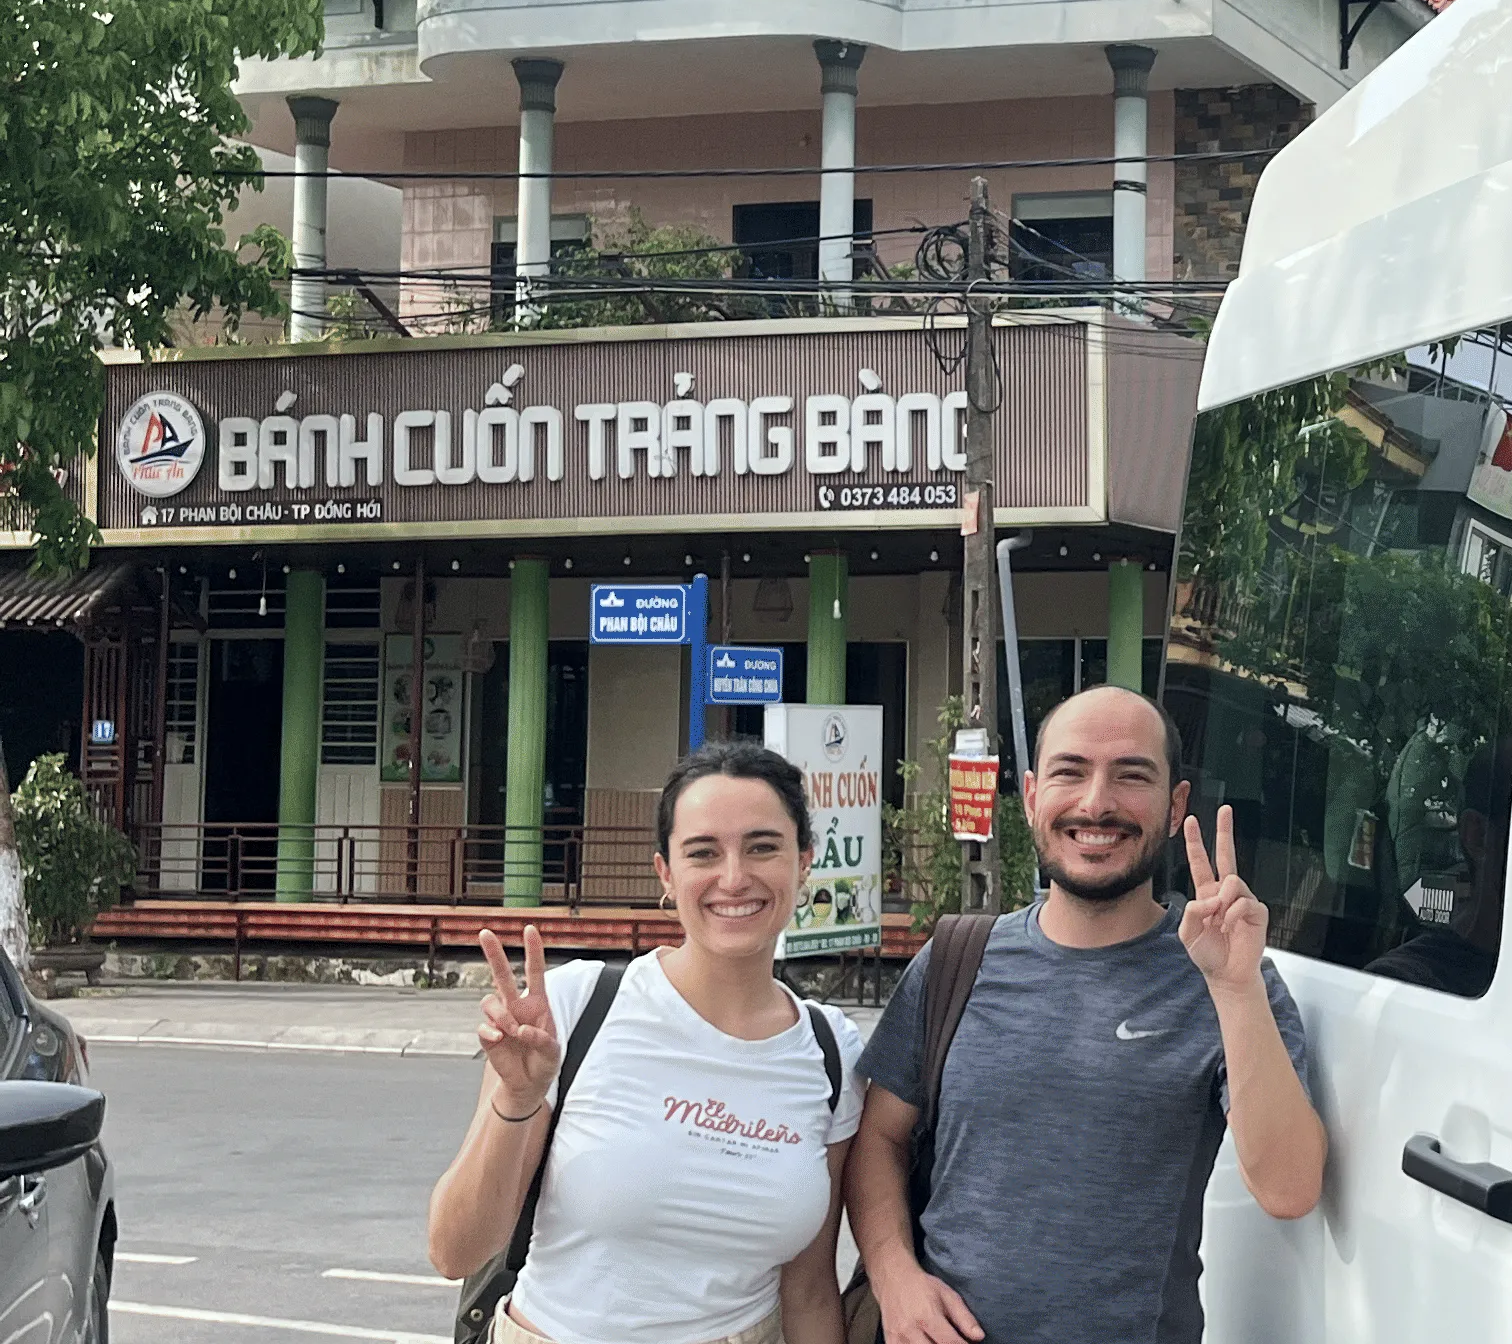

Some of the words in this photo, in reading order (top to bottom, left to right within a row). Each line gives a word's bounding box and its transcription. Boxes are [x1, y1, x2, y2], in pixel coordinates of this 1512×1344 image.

[218, 389, 384, 492] BÁNH
[393, 363, 564, 487] CUỐN
[574, 371, 795, 481] TRẢNG
[840, 486, 884, 507] 0373
[887, 485, 922, 506] 484
[924, 483, 957, 505] 053
[161, 507, 175, 524] 17
[179, 506, 216, 523] PHAN
[220, 503, 242, 524] BỘI
[246, 502, 282, 521] CHÂU
[291, 503, 310, 520] TP
[356, 498, 381, 519] HỚI
[635, 595, 679, 610] ĐƯỜNG
[599, 616, 629, 633] PHAN
[630, 613, 648, 636] BỘI
[650, 612, 678, 633] CHÂU
[837, 754, 878, 809] CUỐN
[664, 1096, 801, 1145] Madrileño
[704, 1098, 726, 1119] El
